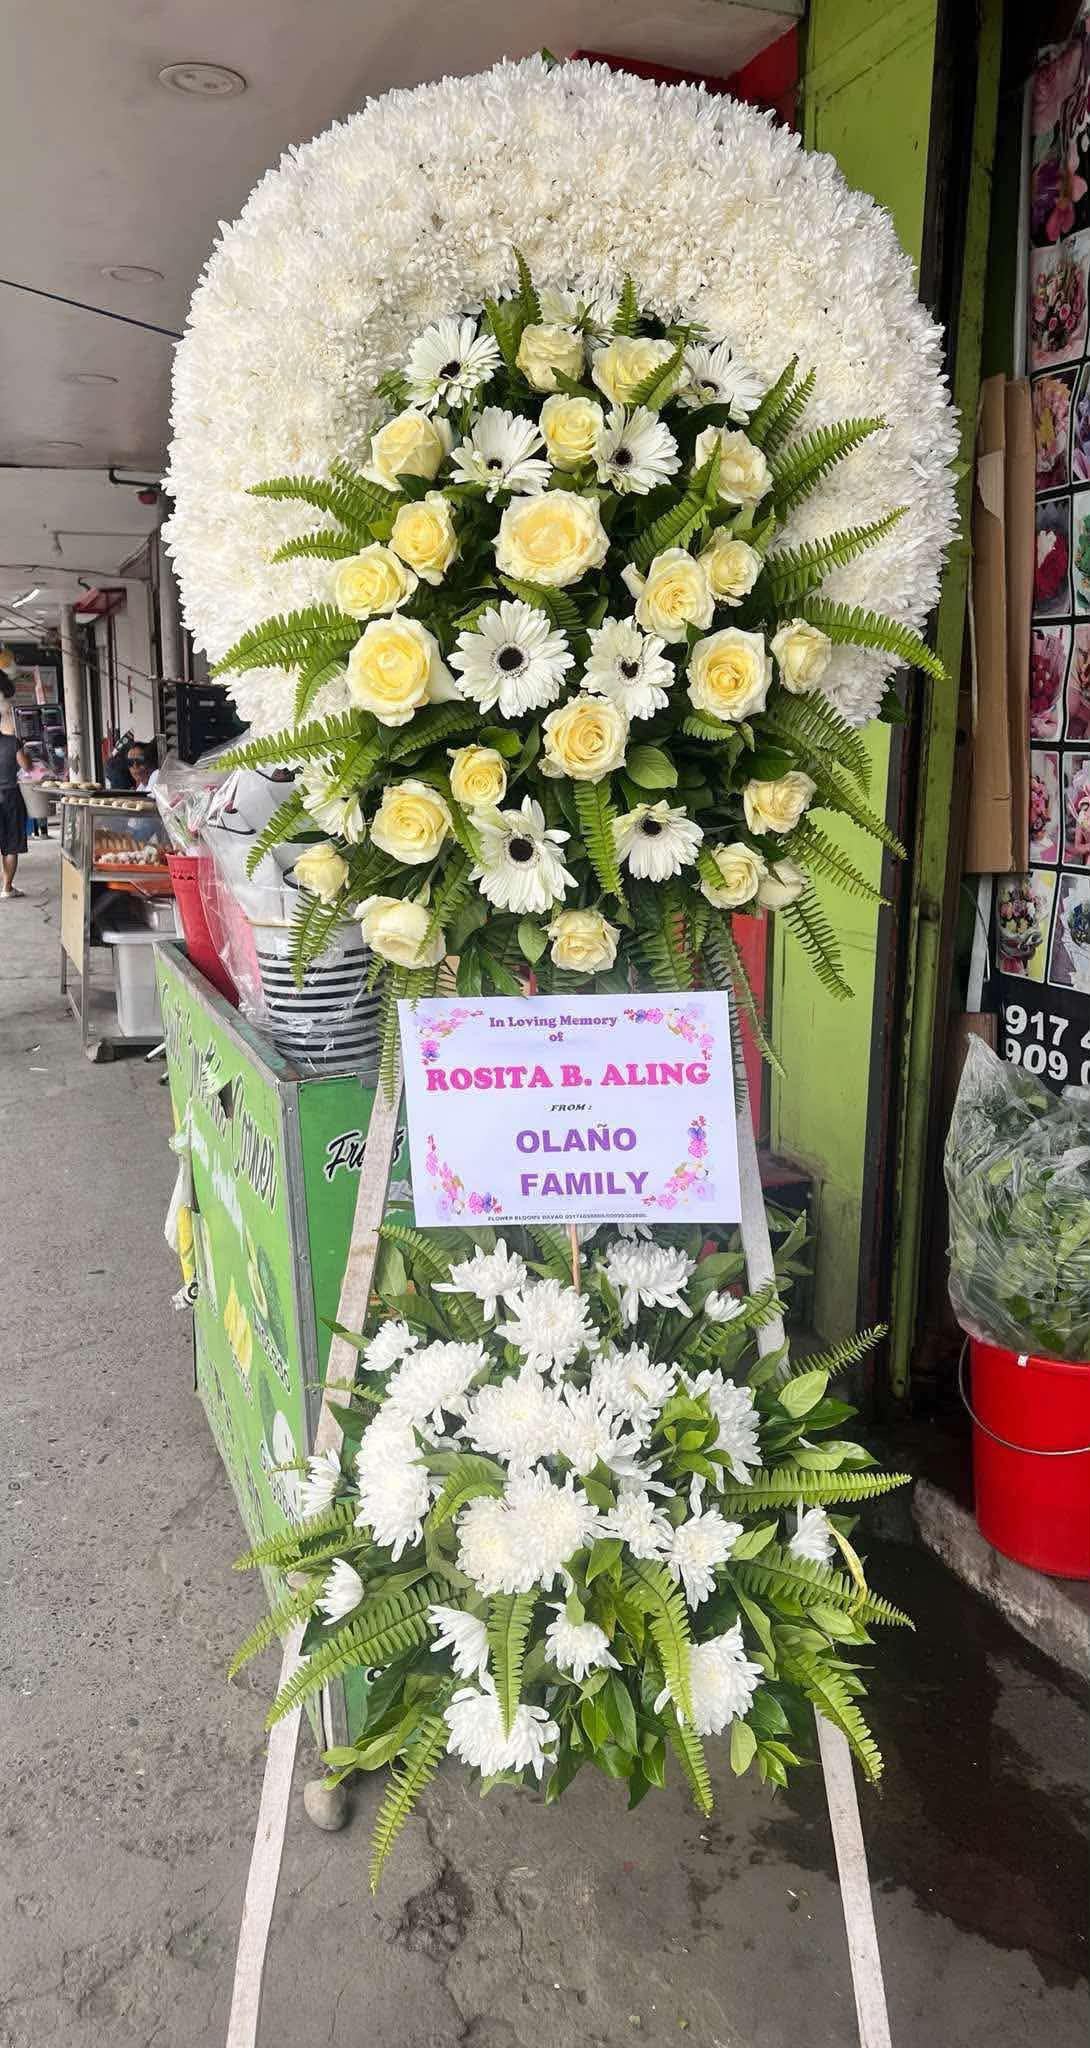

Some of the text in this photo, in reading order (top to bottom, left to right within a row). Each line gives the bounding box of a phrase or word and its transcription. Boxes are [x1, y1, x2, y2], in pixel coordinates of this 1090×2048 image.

[489, 1015, 617, 1028] In Loving Memory
[1006, 1005, 1068, 1046] 917
[549, 1032, 564, 1042] of
[426, 1062, 711, 1091] ROSITA B. ALING
[516, 1123, 637, 1153] OLAÑO
[520, 1171, 649, 1196] FAMILY
